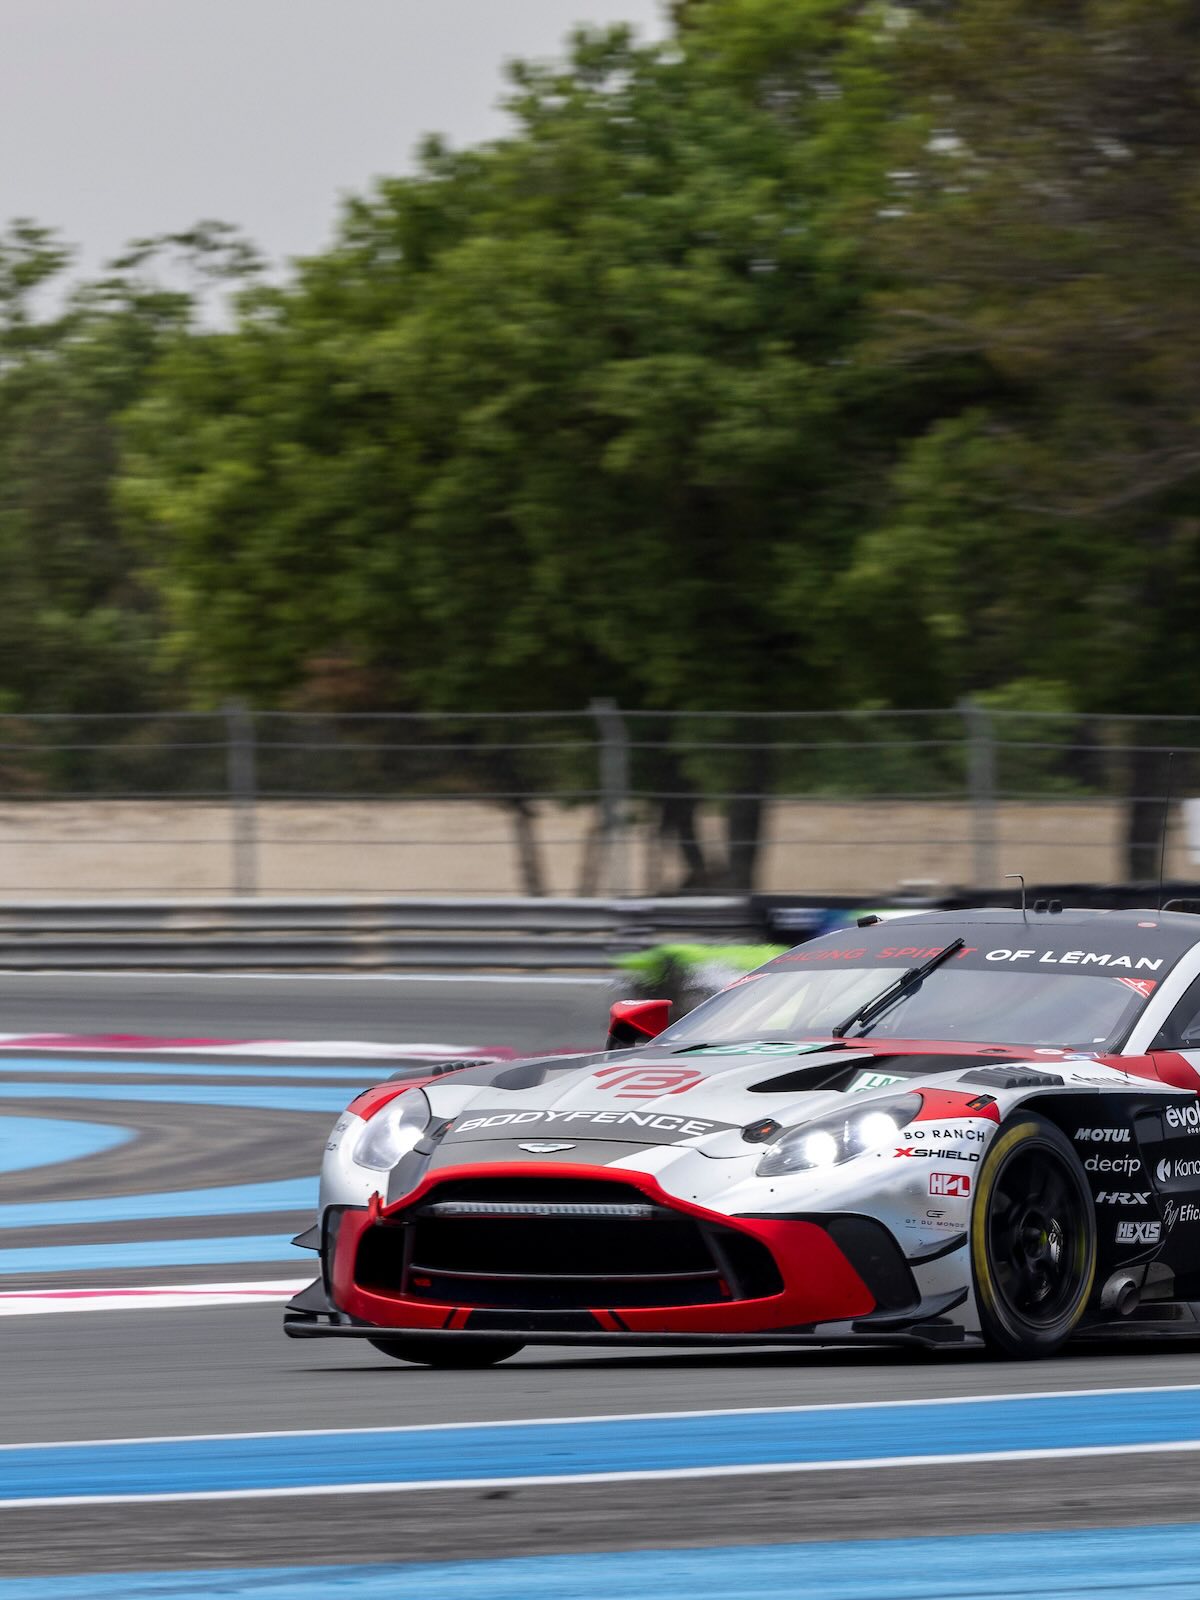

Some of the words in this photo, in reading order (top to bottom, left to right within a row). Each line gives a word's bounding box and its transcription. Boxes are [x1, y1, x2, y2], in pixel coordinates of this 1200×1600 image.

[874, 947, 977, 960] SPIRT
[985, 949, 1036, 962] OF
[1038, 950, 1164, 971] LÉMAN
[454, 1110, 714, 1137] BODYFENCE
[904, 1131, 925, 1140] BO
[932, 1129, 985, 1143] RANCH
[1074, 1128, 1131, 1143] MOTUL
[893, 1147, 980, 1162] XSHIELD
[1084, 1154, 1141, 1177] decip
[930, 1173, 970, 1197] HPL
[1095, 1191, 1152, 1205] HRX
[1116, 1221, 1161, 1244] HEXIS
